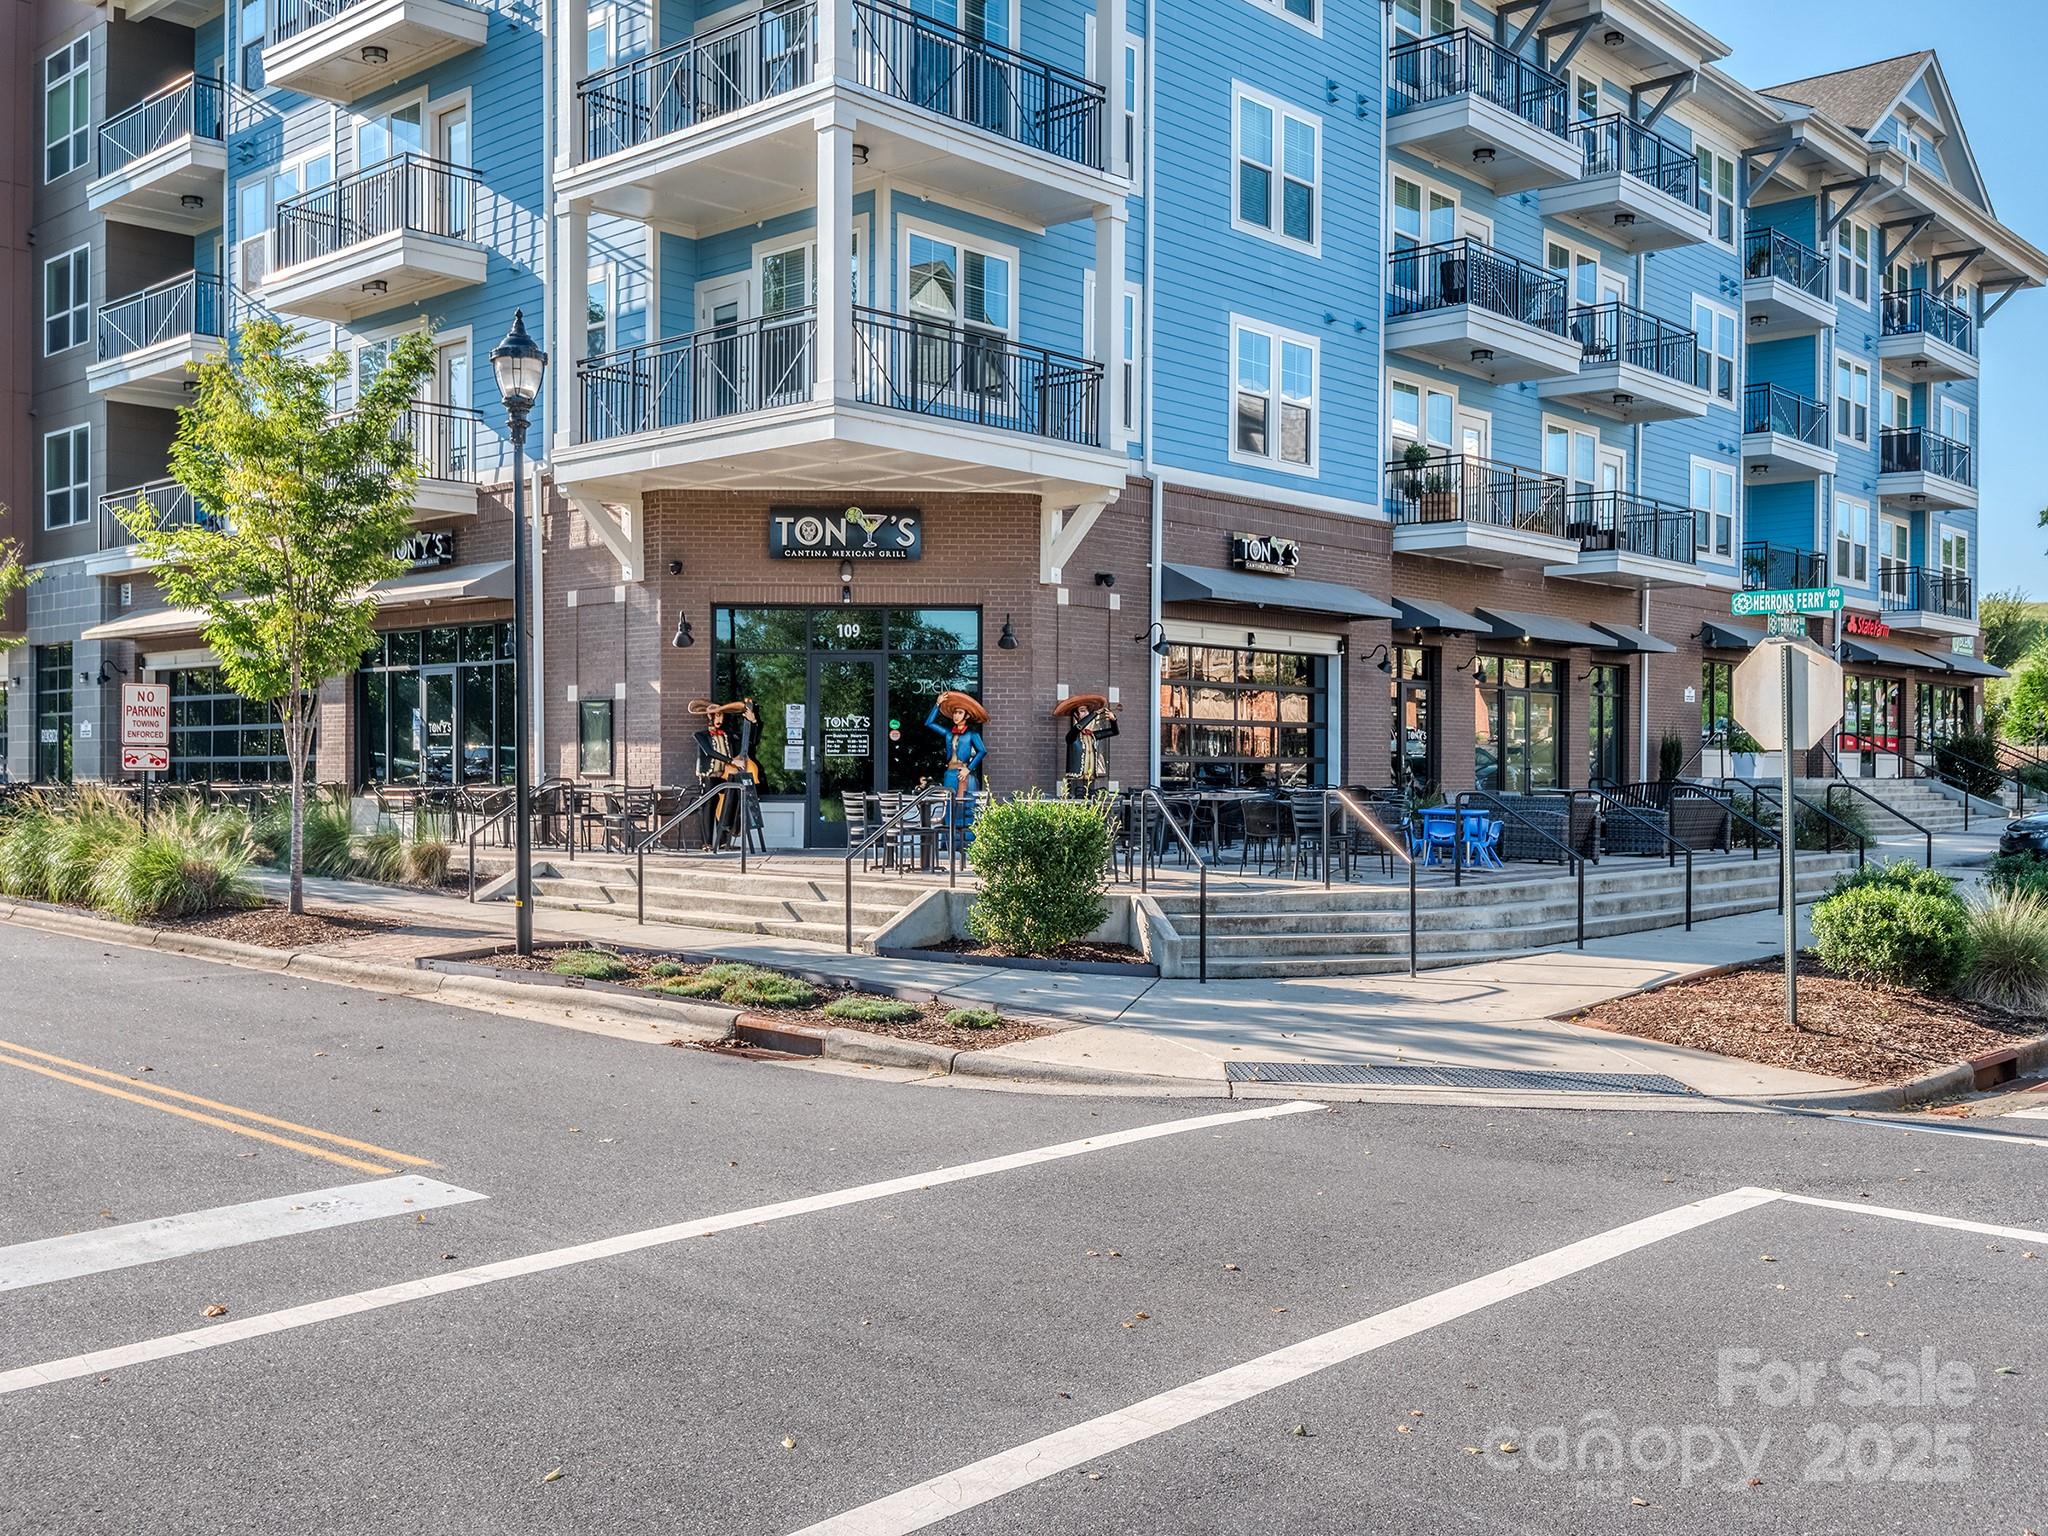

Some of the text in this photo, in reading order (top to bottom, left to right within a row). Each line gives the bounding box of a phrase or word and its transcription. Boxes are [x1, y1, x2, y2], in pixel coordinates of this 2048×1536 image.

[775, 507, 916, 548] TONY'S
[784, 550, 906, 558] CANTINA MEXICAN GRILL
[1242, 536, 1299, 566] TONY'S
[1827, 589, 1840, 597] 600
[1753, 591, 1825, 610] HERRONS FERRY
[1829, 600, 1839, 609] RD
[836, 624, 860, 638] 109
[137, 691, 155, 702] NO
[126, 705, 166, 717] PARKING
[132, 720, 160, 728] TOWING
[824, 714, 871, 728] TONY'S
[127, 730, 164, 738] ENFORCED
